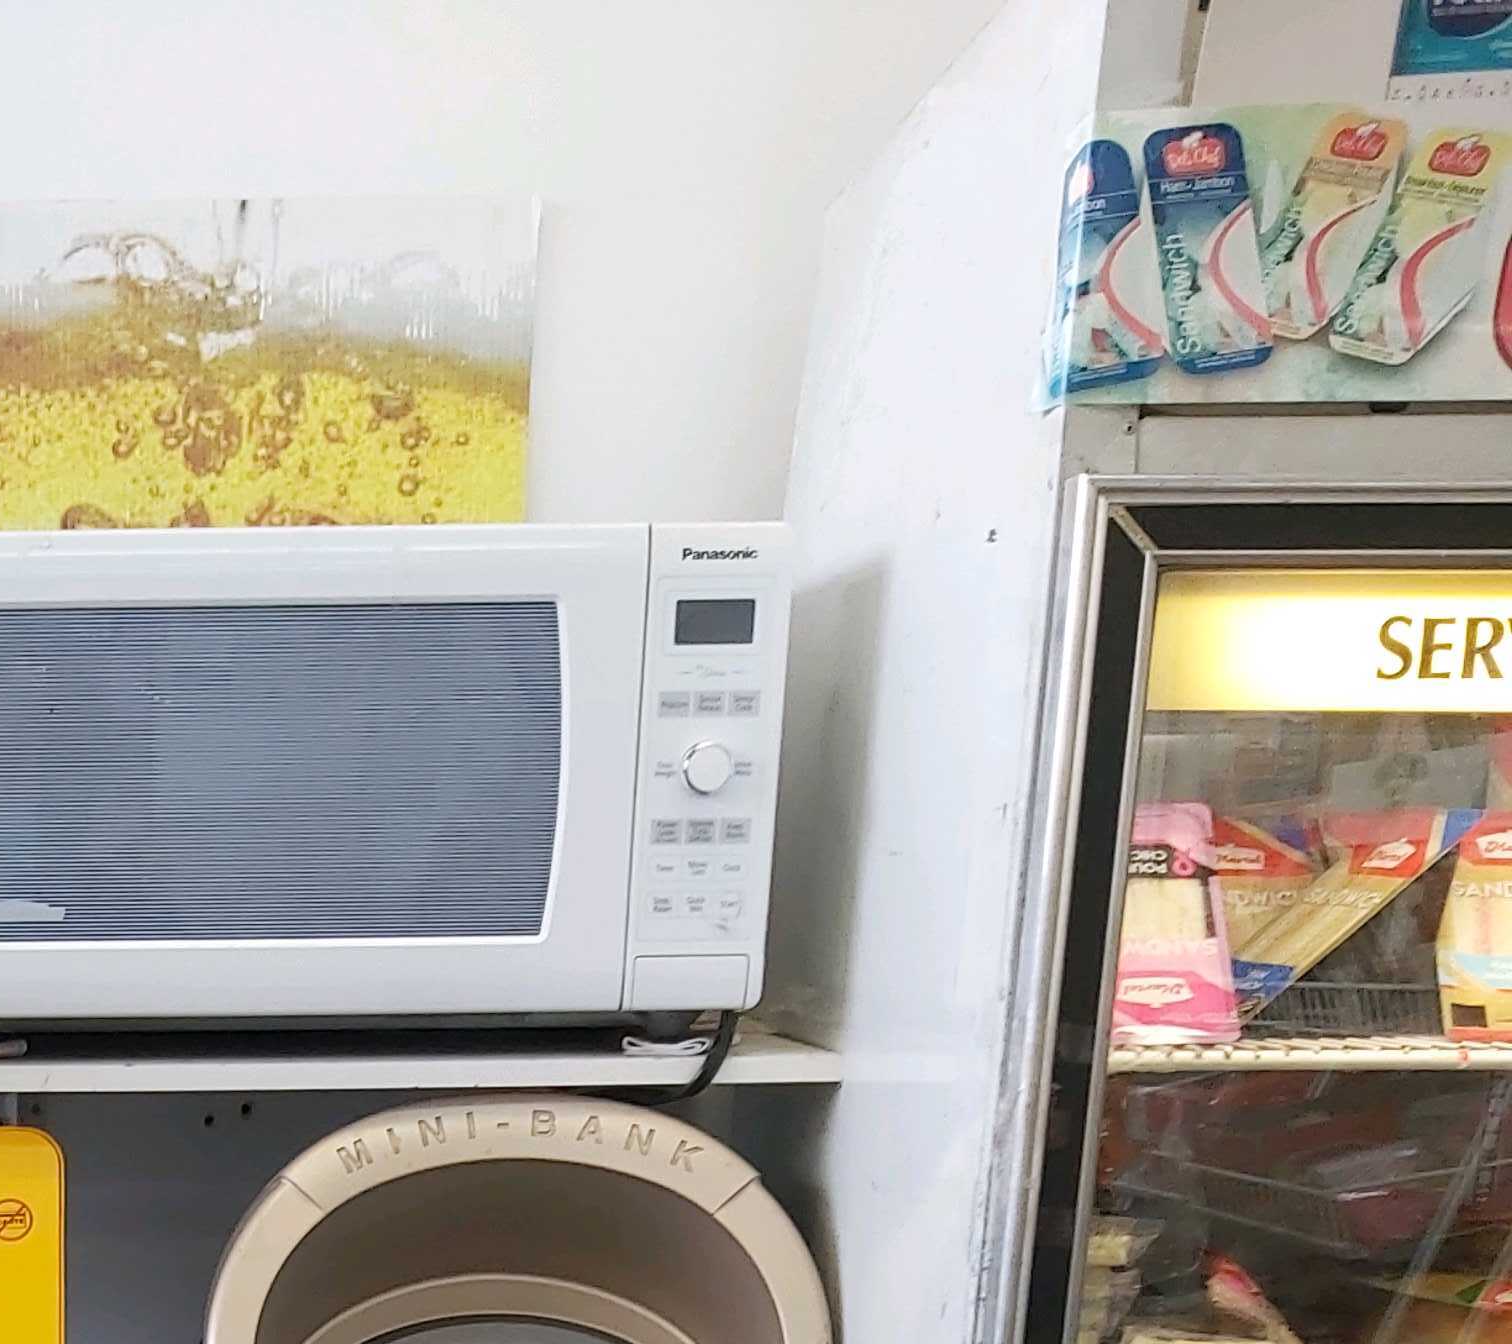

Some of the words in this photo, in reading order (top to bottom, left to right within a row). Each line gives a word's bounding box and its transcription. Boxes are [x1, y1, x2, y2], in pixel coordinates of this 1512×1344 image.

[1164, 231, 1202, 354] Sandwich
[681, 547, 759, 561] Panasonic
[1376, 615, 1512, 680] SER
[336, 1109, 706, 1175] MINI-BANK
